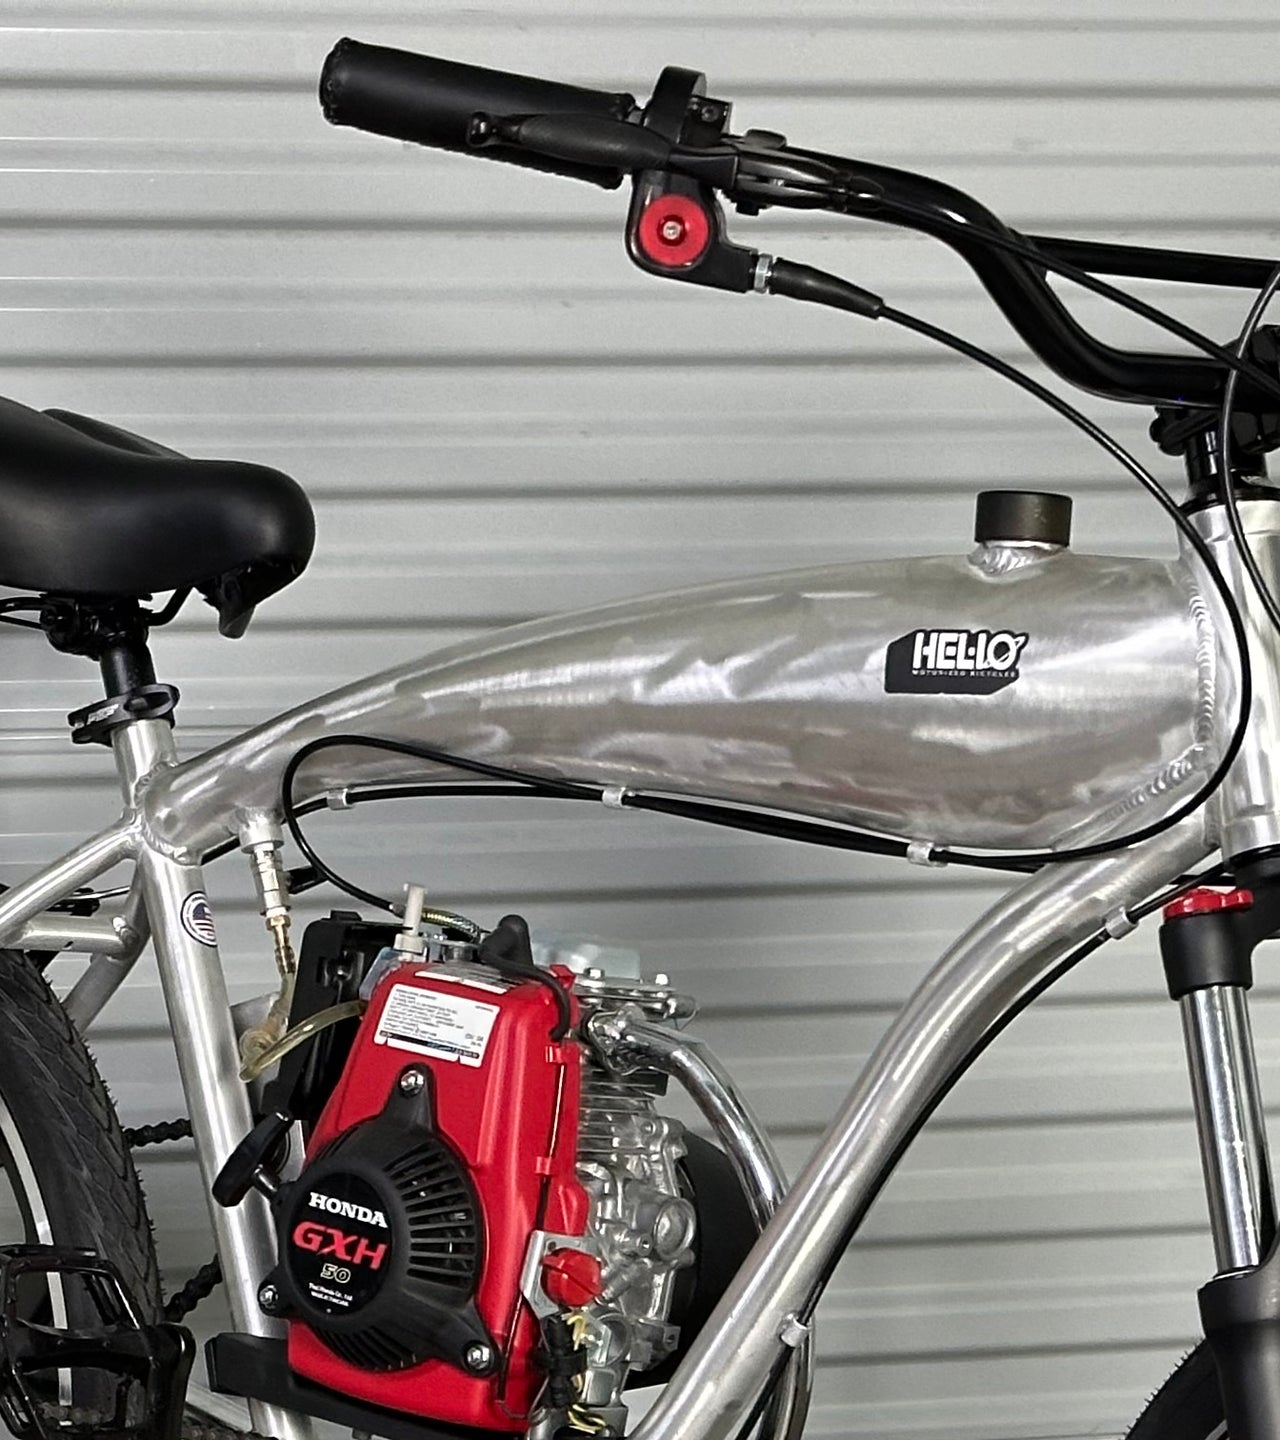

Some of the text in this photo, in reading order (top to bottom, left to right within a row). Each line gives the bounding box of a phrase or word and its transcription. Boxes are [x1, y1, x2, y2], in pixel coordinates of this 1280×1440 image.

[308, 1191, 389, 1228] HONDA
[293, 1221, 388, 1270] GXH
[320, 1263, 351, 1283] 50
